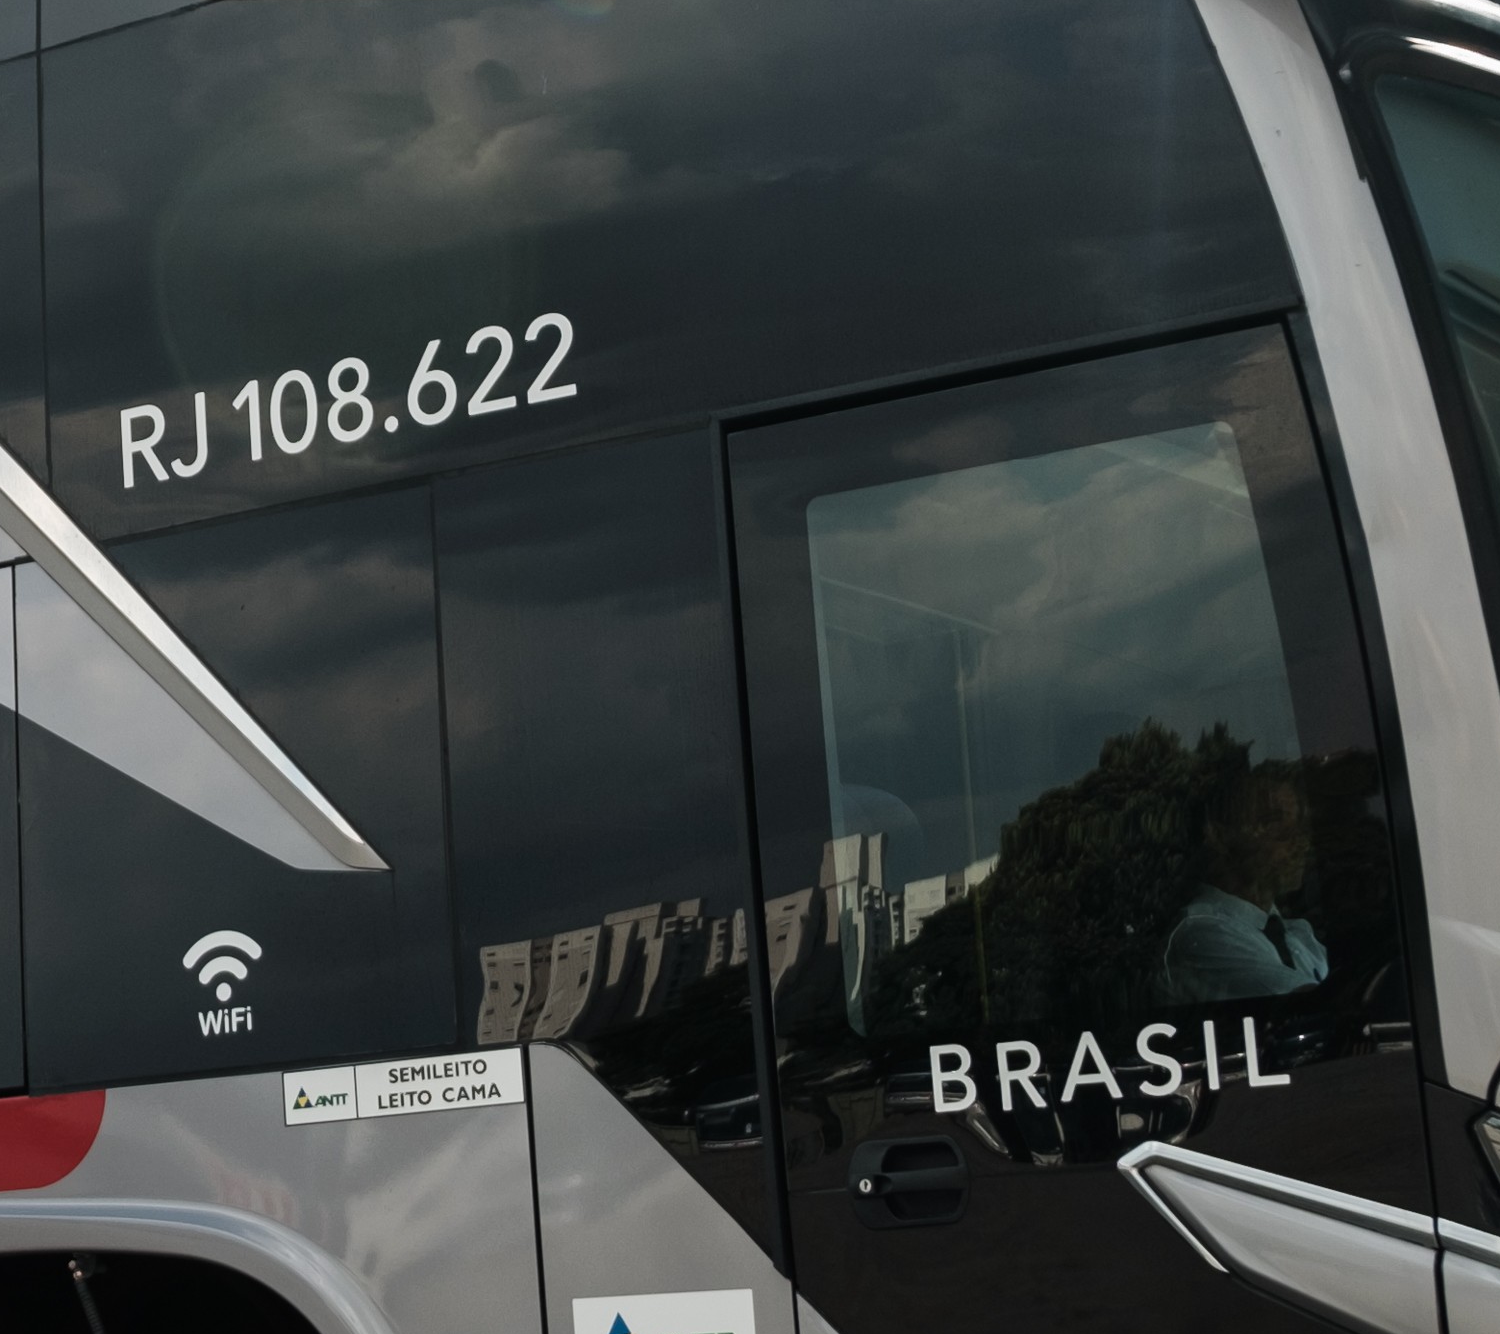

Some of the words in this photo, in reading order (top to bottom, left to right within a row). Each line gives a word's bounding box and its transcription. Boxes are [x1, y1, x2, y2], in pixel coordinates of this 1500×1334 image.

[119, 391, 209, 488] RJ
[232, 312, 578, 462] 108.622
[198, 1005, 253, 1037] WiFi
[388, 1058, 488, 1084] SEMILEITO
[928, 1016, 1292, 1113] BRASIL
[314, 1092, 349, 1108] ANTT
[377, 1089, 432, 1110] LEITO
[442, 1082, 502, 1103] CAMA
